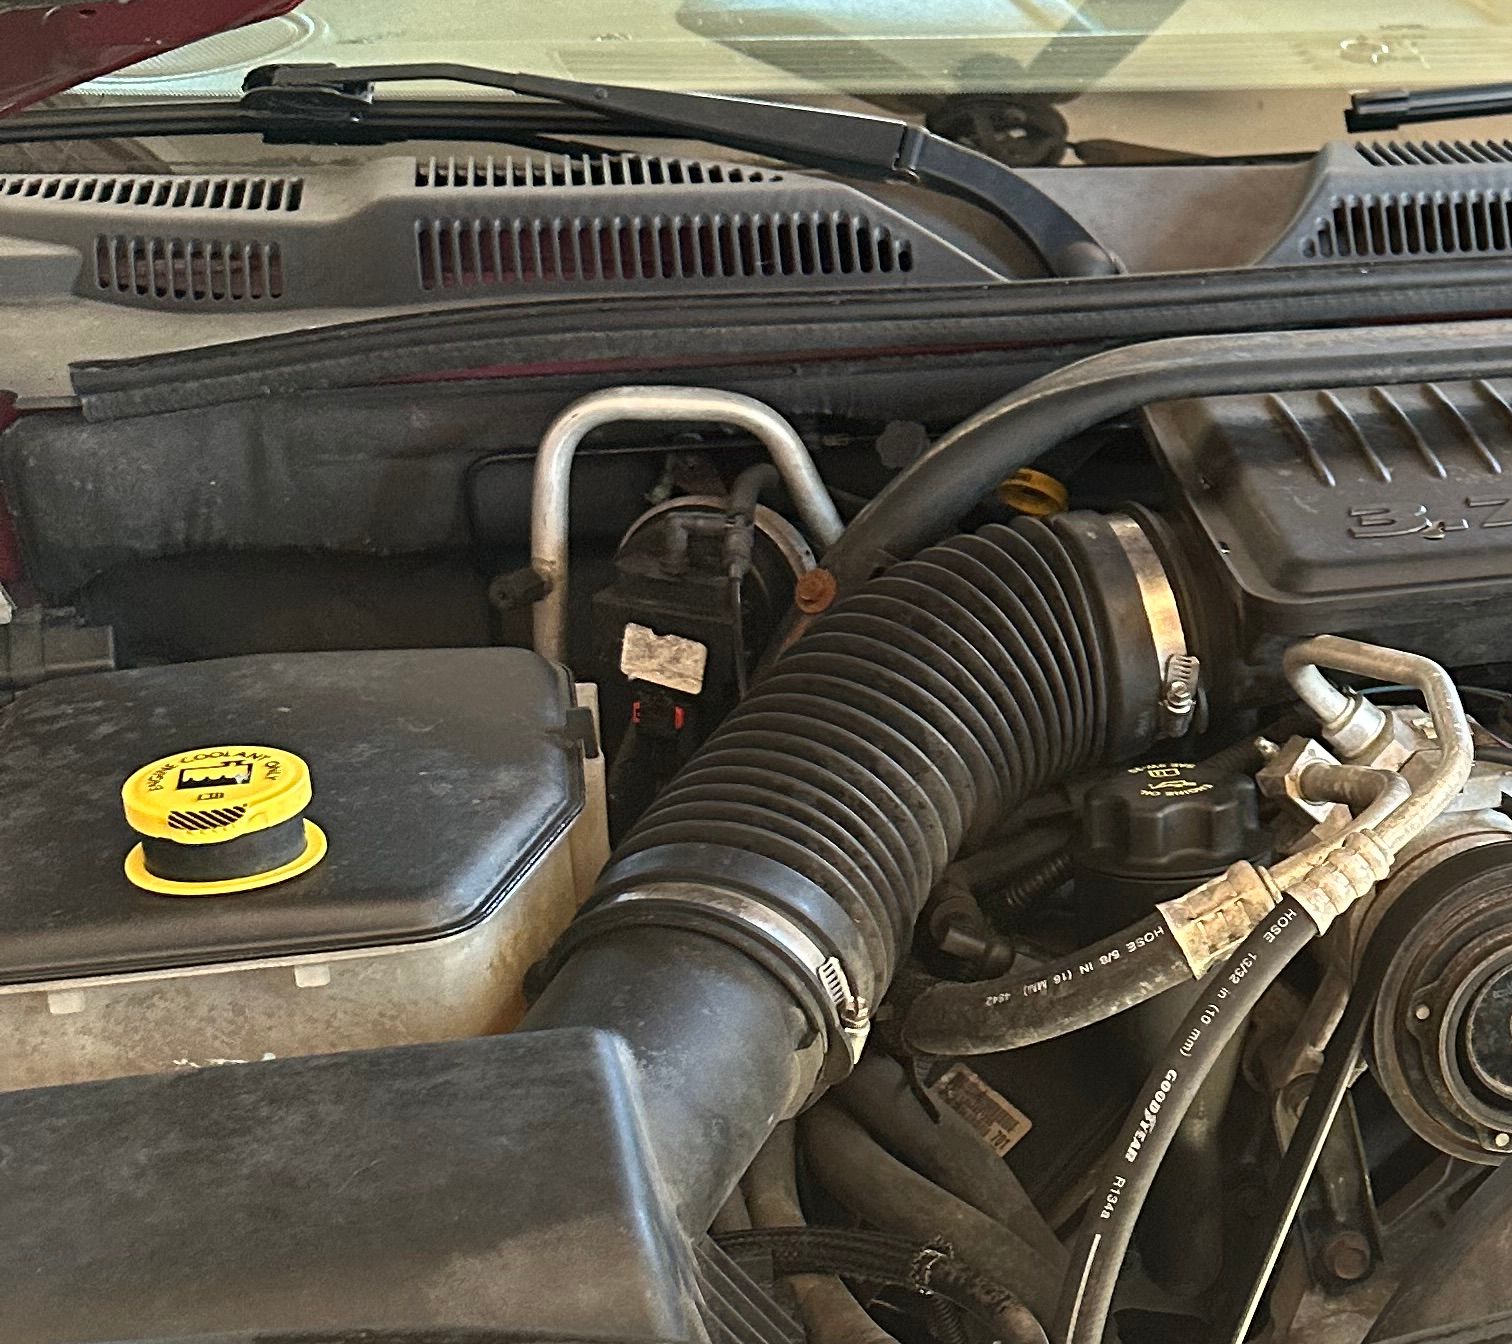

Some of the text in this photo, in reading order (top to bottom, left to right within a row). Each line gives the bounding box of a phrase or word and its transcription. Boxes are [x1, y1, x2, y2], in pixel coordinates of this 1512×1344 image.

[147, 751, 282, 792] ENGINE COOLANT ONLY
[1125, 926, 1164, 953] HOSE
[1099, 949, 1121, 965] 5/8
[1053, 970, 1073, 985] (16
[1079, 962, 1094, 975] IN
[1100, 909, 1297, 1219] HOSE 13/32 in (10 mm) GOODYEAR R134a
